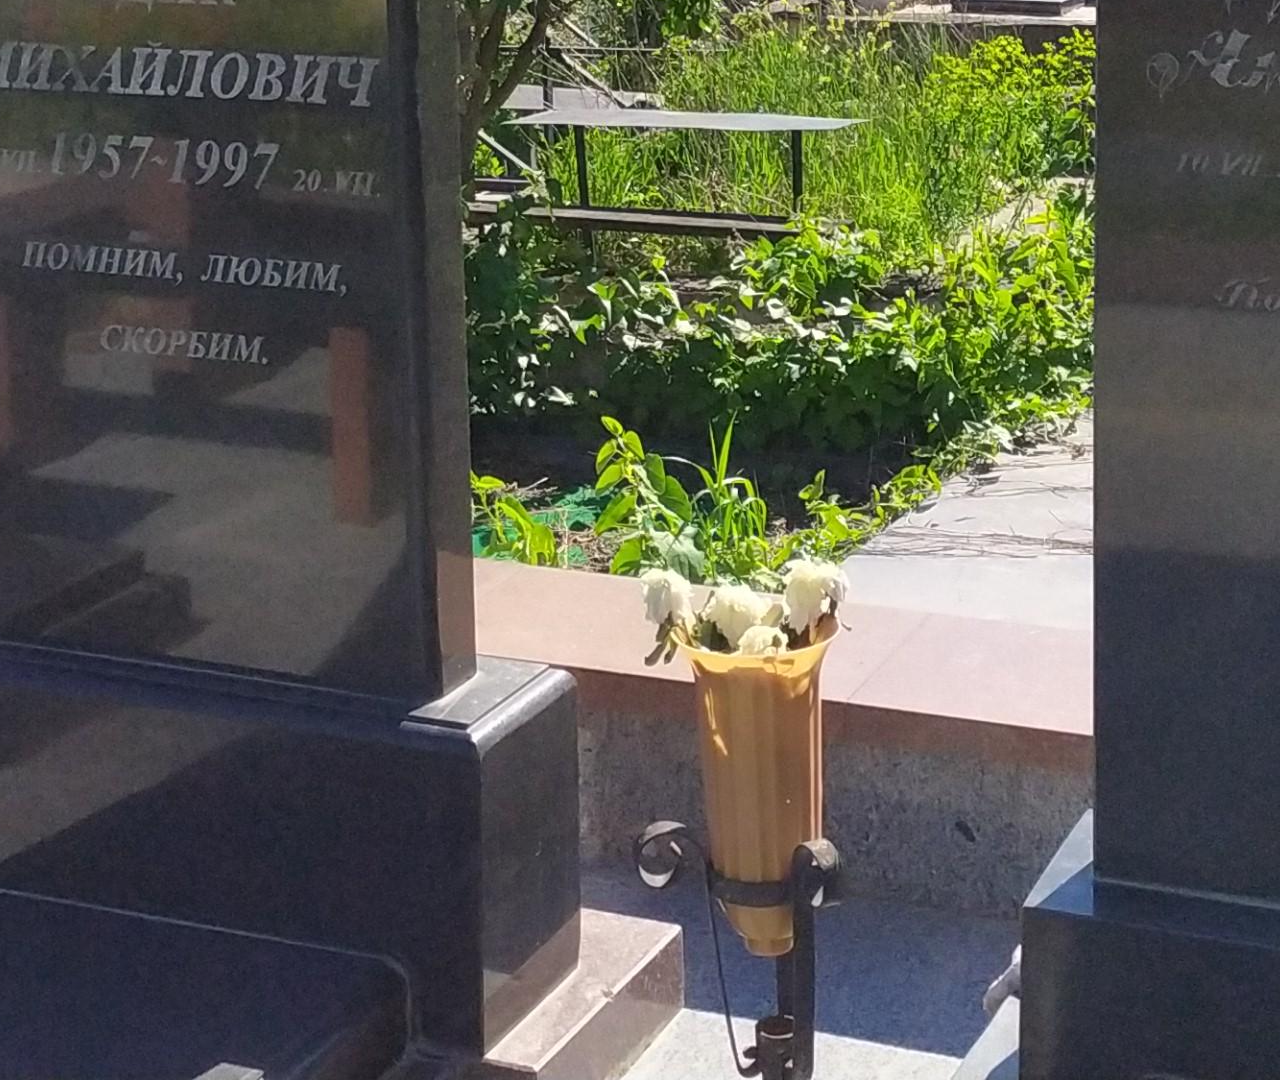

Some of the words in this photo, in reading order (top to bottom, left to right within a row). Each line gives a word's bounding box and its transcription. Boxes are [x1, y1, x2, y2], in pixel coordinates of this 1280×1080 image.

[22, 239, 184, 286] ПОМНИМ,
[200, 253, 349, 296] ЛЮБИМ,
[100, 323, 270, 366] СКОРБИМ.
